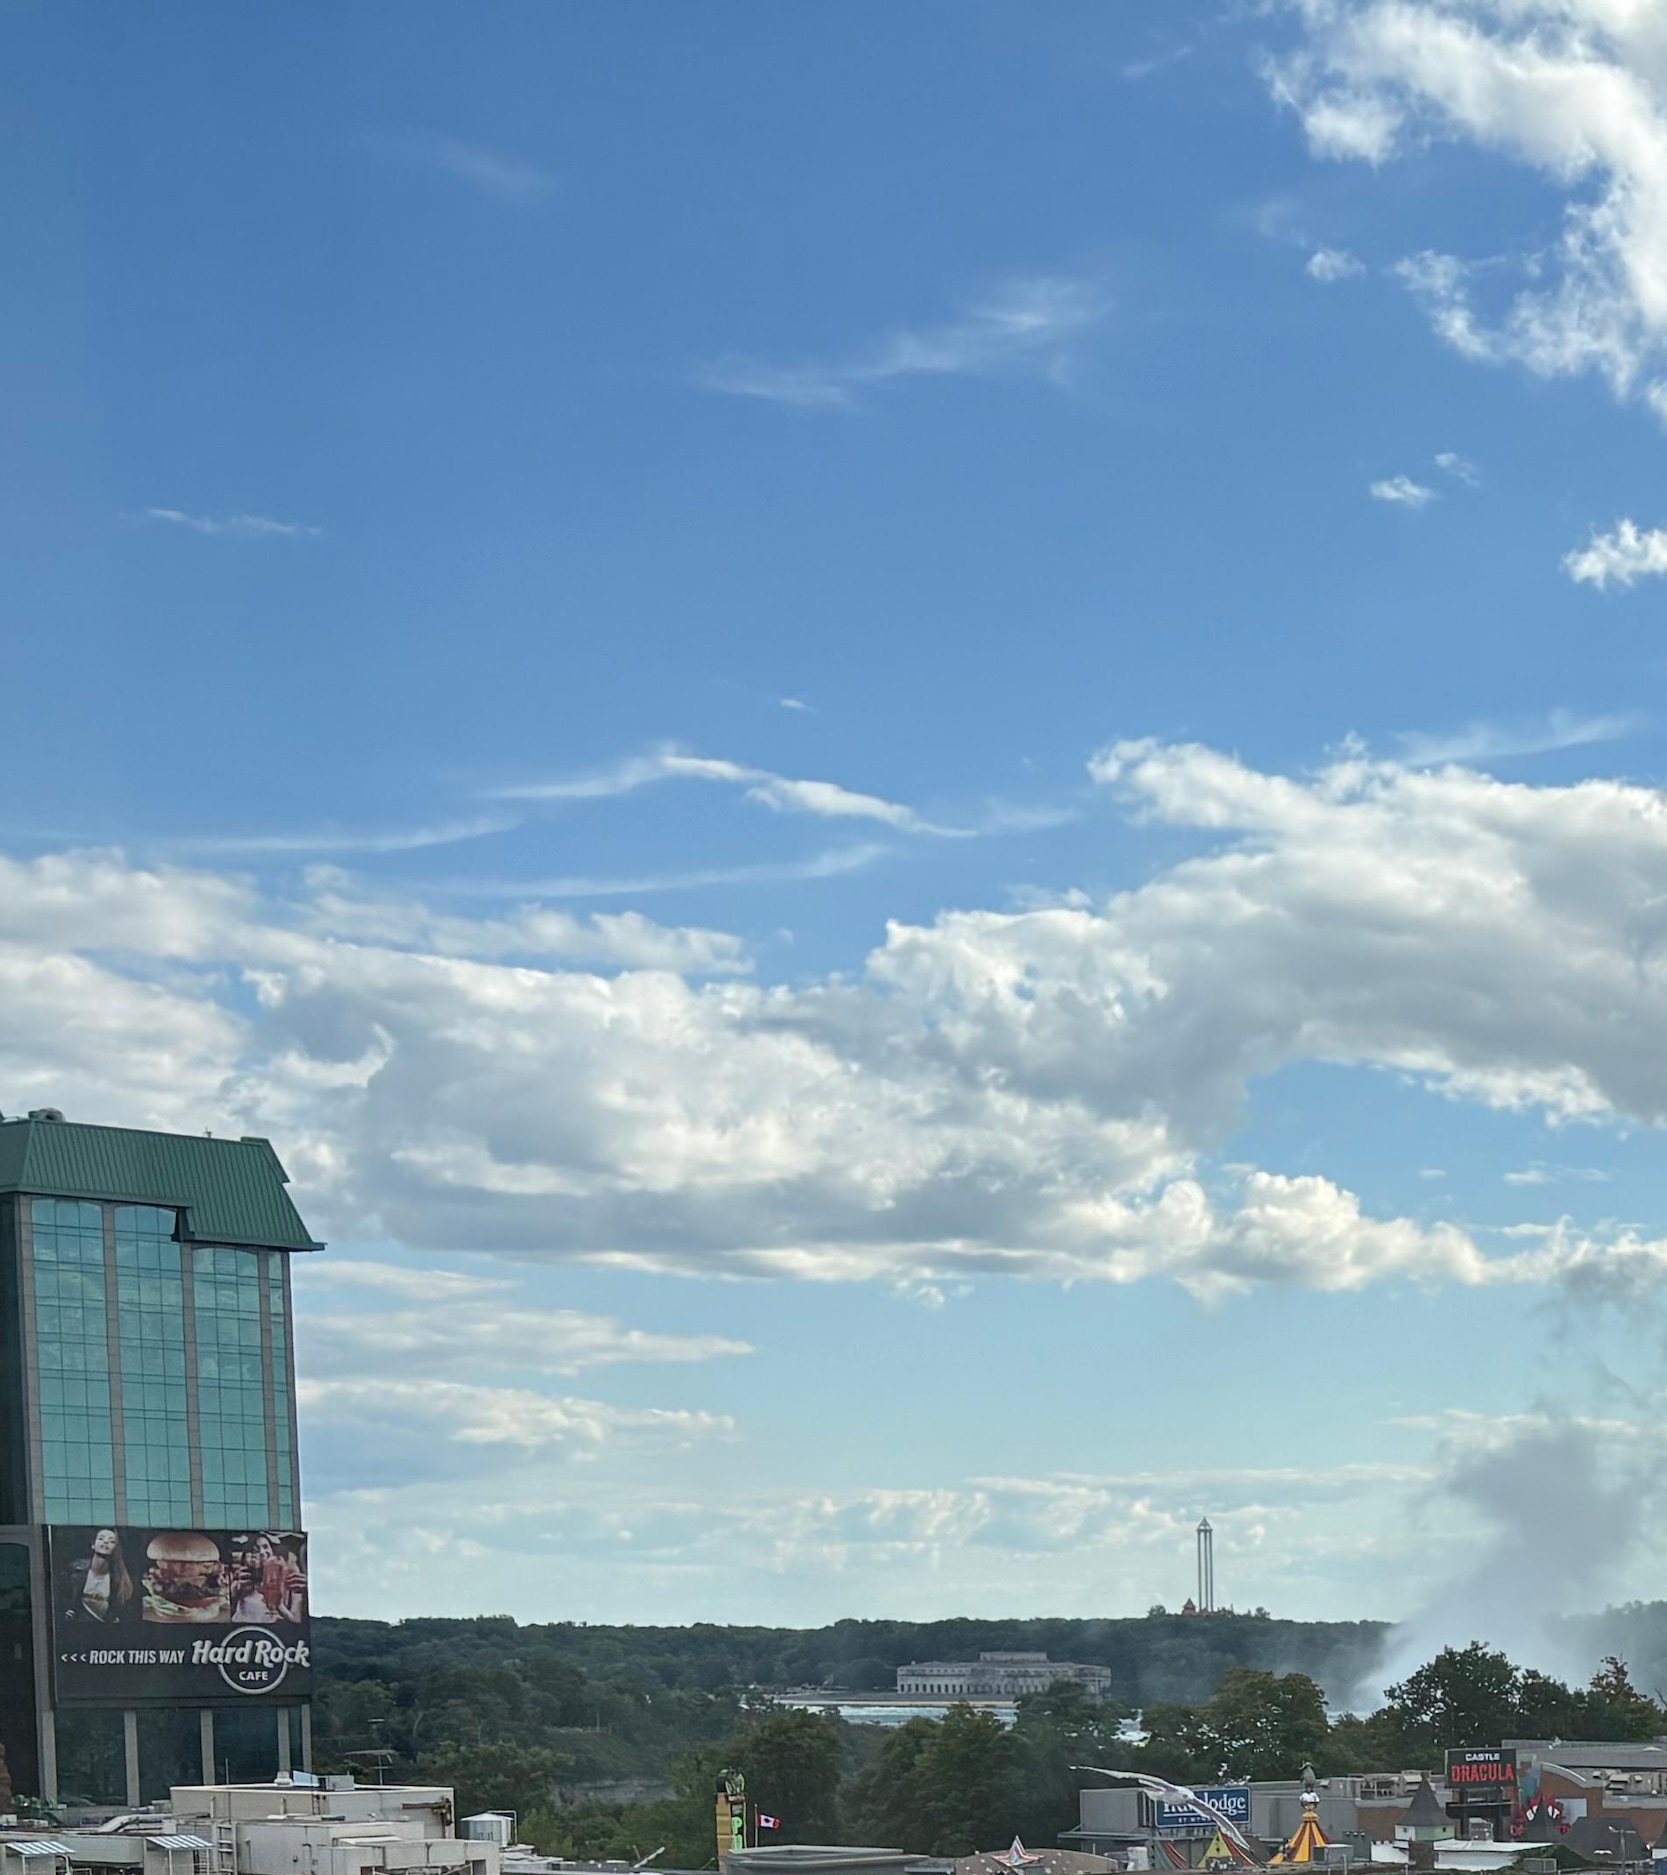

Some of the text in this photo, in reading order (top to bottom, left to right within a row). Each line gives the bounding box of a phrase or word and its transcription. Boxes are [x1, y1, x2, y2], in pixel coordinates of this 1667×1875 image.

[89, 1649, 186, 1665] ROCK THIS WAY
[191, 1639, 310, 1668] Hard Rock
[238, 1671, 269, 1681] CAFE
[1465, 1752, 1500, 1762] CASTLE
[1451, 1763, 1514, 1783] DRACULA
